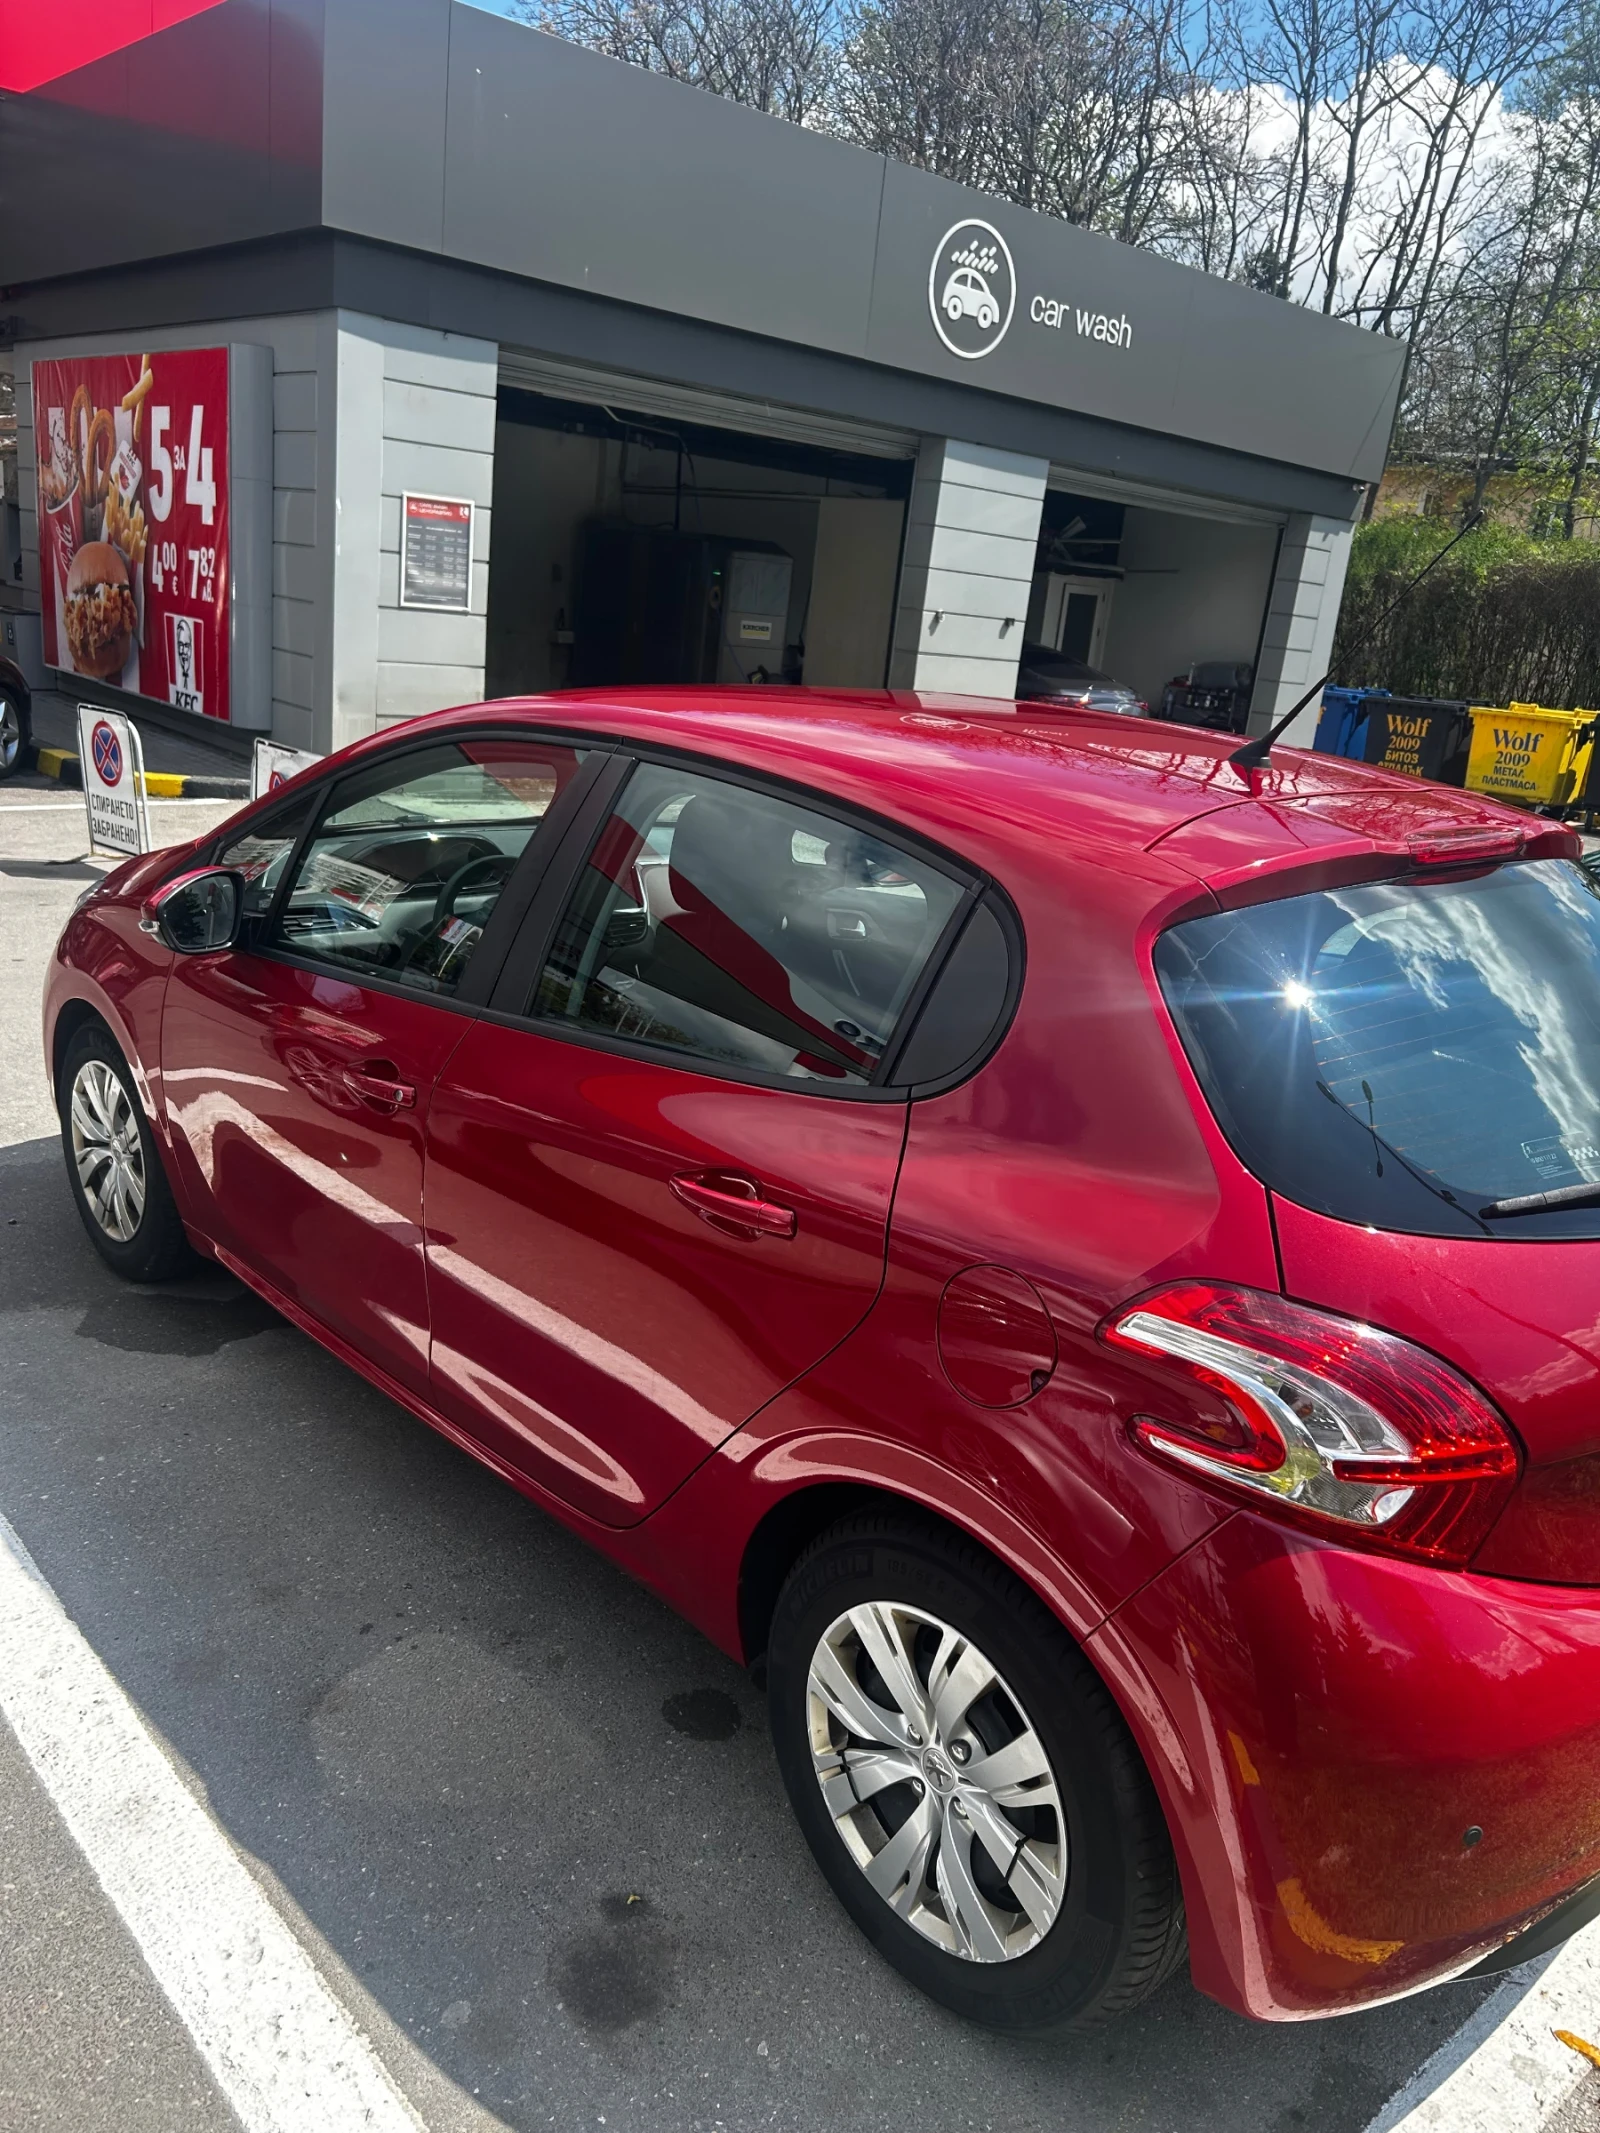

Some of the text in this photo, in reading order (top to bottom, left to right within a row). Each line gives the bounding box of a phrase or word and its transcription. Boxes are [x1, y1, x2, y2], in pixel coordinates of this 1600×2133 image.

[1030, 295, 1133, 349] car wash
[148, 405, 173, 522] 5
[185, 404, 217, 525] 4
[175, 690, 199, 711] KFC
[1387, 714, 1432, 737] Wolf
[1388, 735, 1420, 751] 2009
[1493, 728, 1545, 753] Wolf
[1494, 750, 1531, 767] 2009
[1481, 774, 1536, 791] ПЛАСТМАСА
[91, 793, 134, 820] СПИРАНЕТО
[92, 817, 138, 846] ЗАБРАНЕНО!
